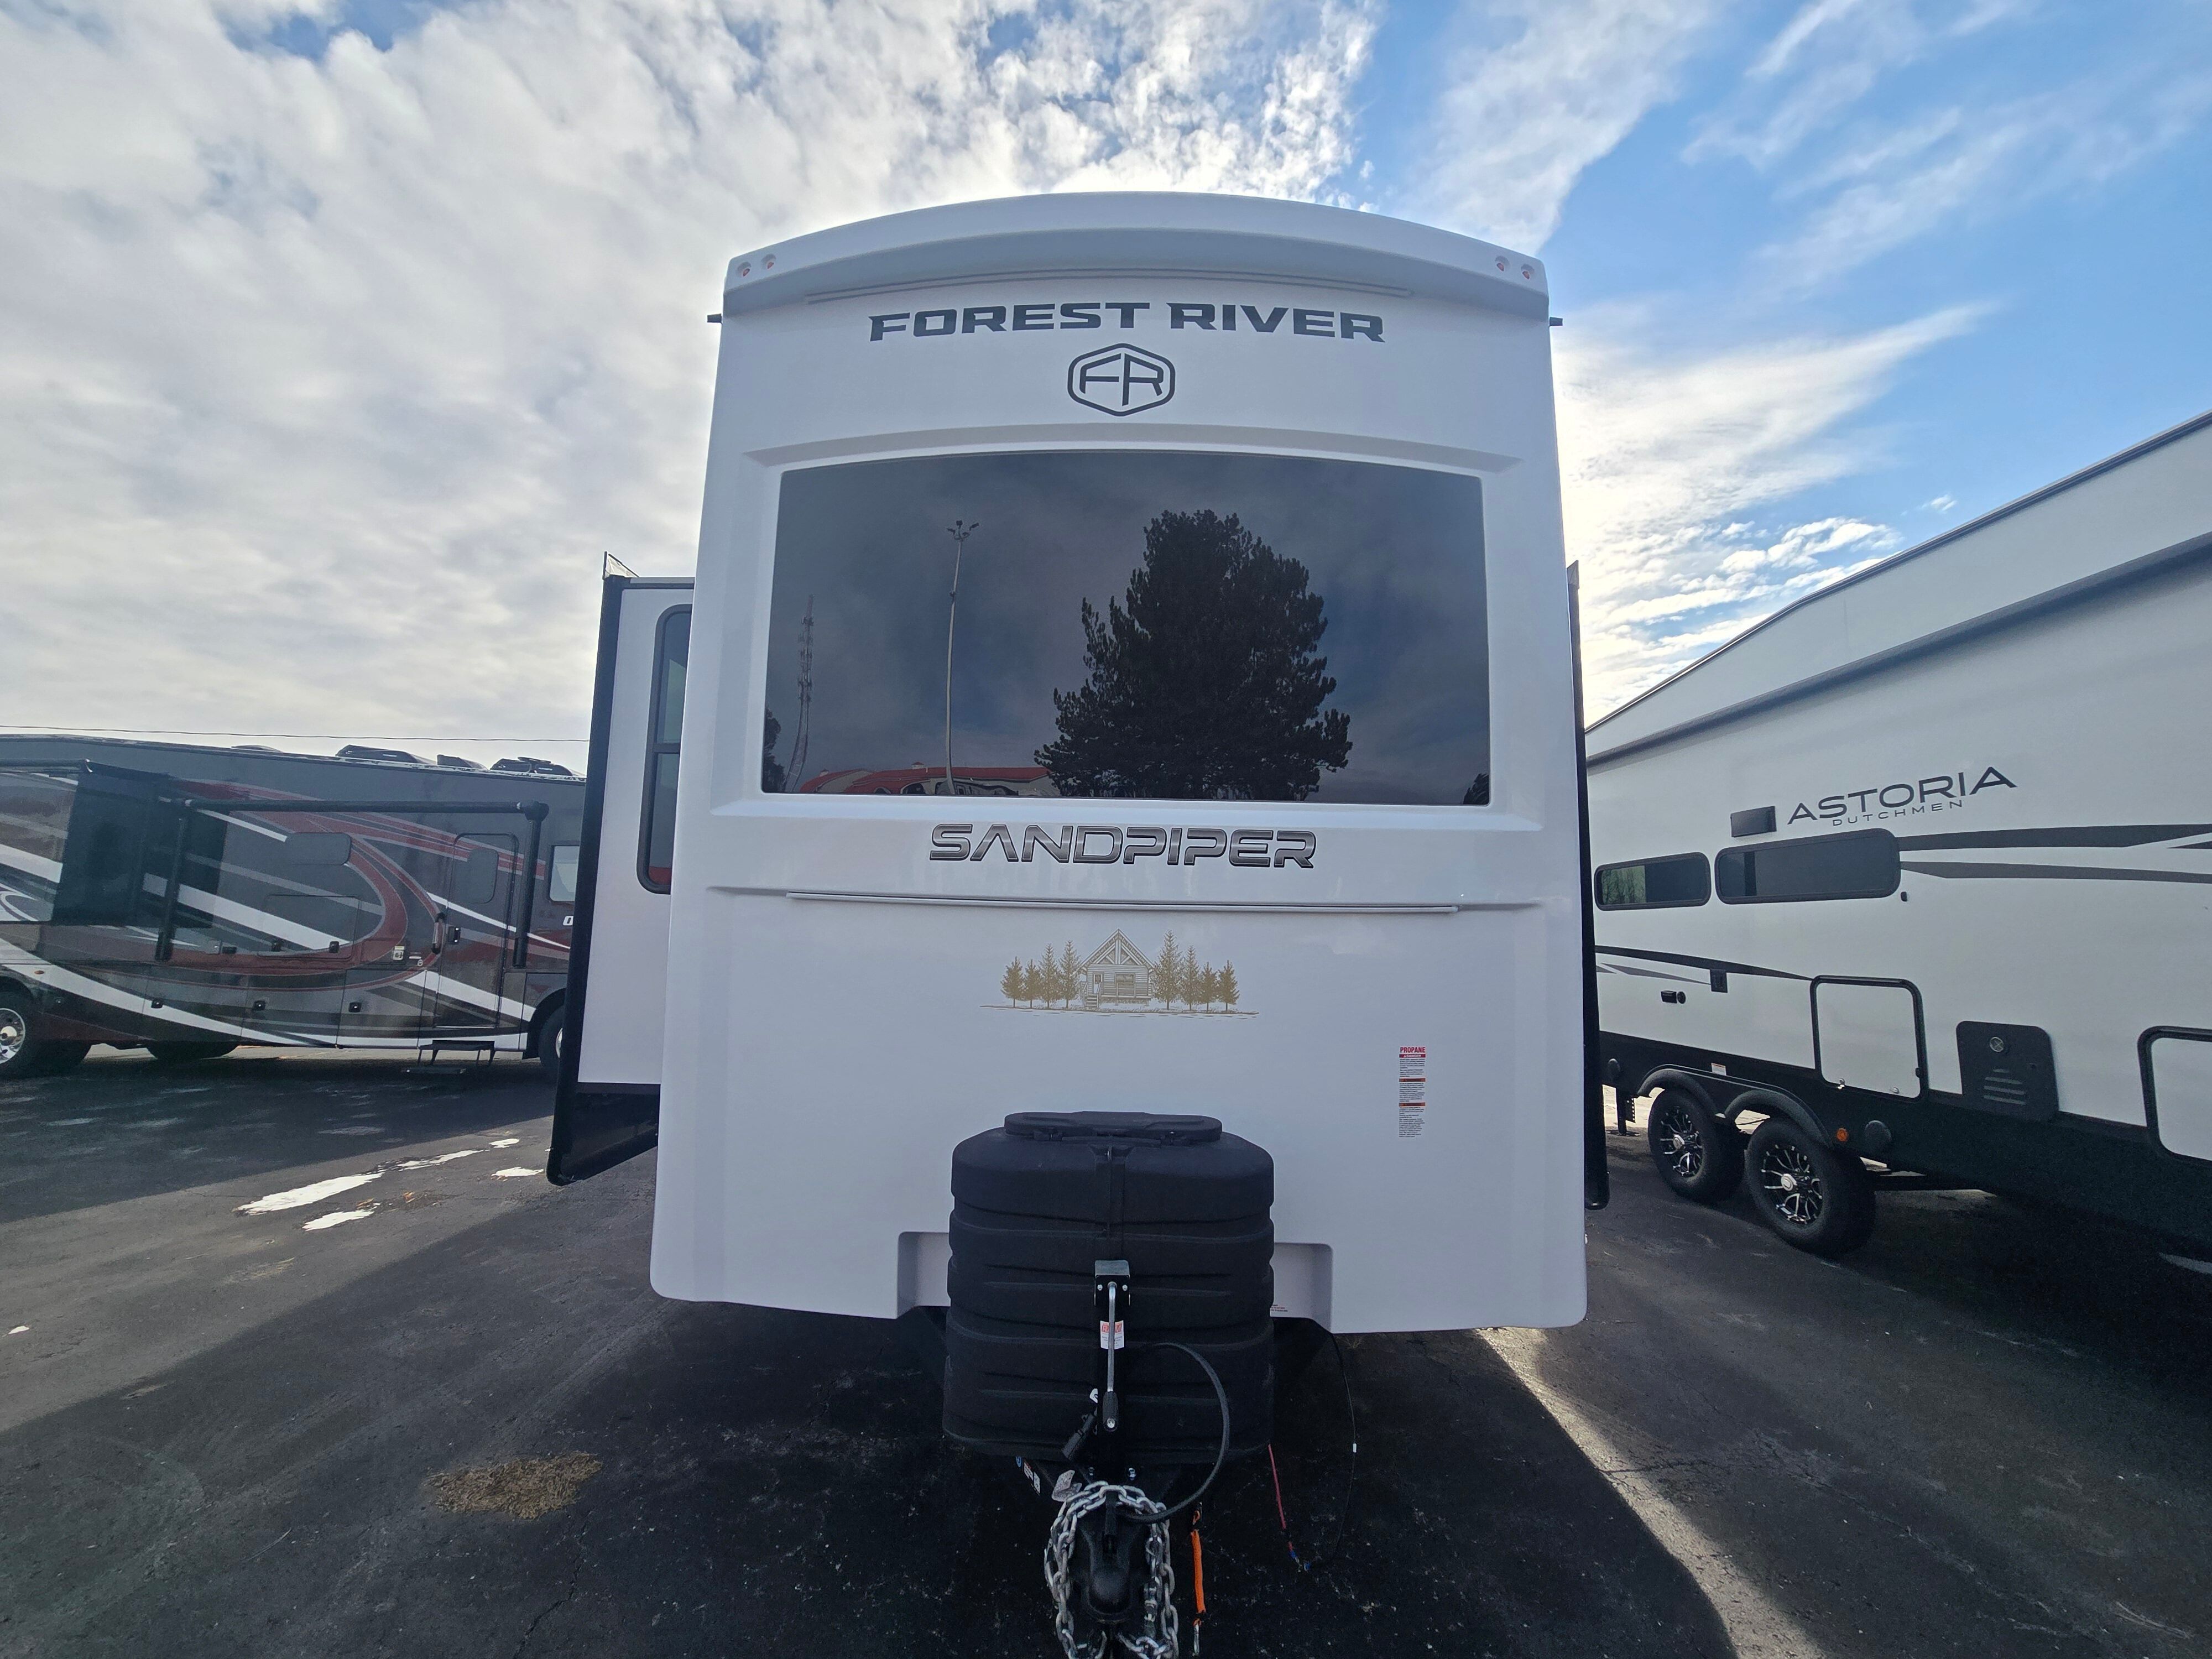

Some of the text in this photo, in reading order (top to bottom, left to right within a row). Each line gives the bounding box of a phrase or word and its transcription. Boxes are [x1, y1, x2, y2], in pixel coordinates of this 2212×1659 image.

[868, 302, 1386, 343] FOREST RIVER
[1079, 353, 1164, 406] FR
[1787, 766, 2018, 825] ASTORIA
[1833, 800, 1963, 826] DUTCHMEN
[930, 823, 1317, 869] SANDPIPER
